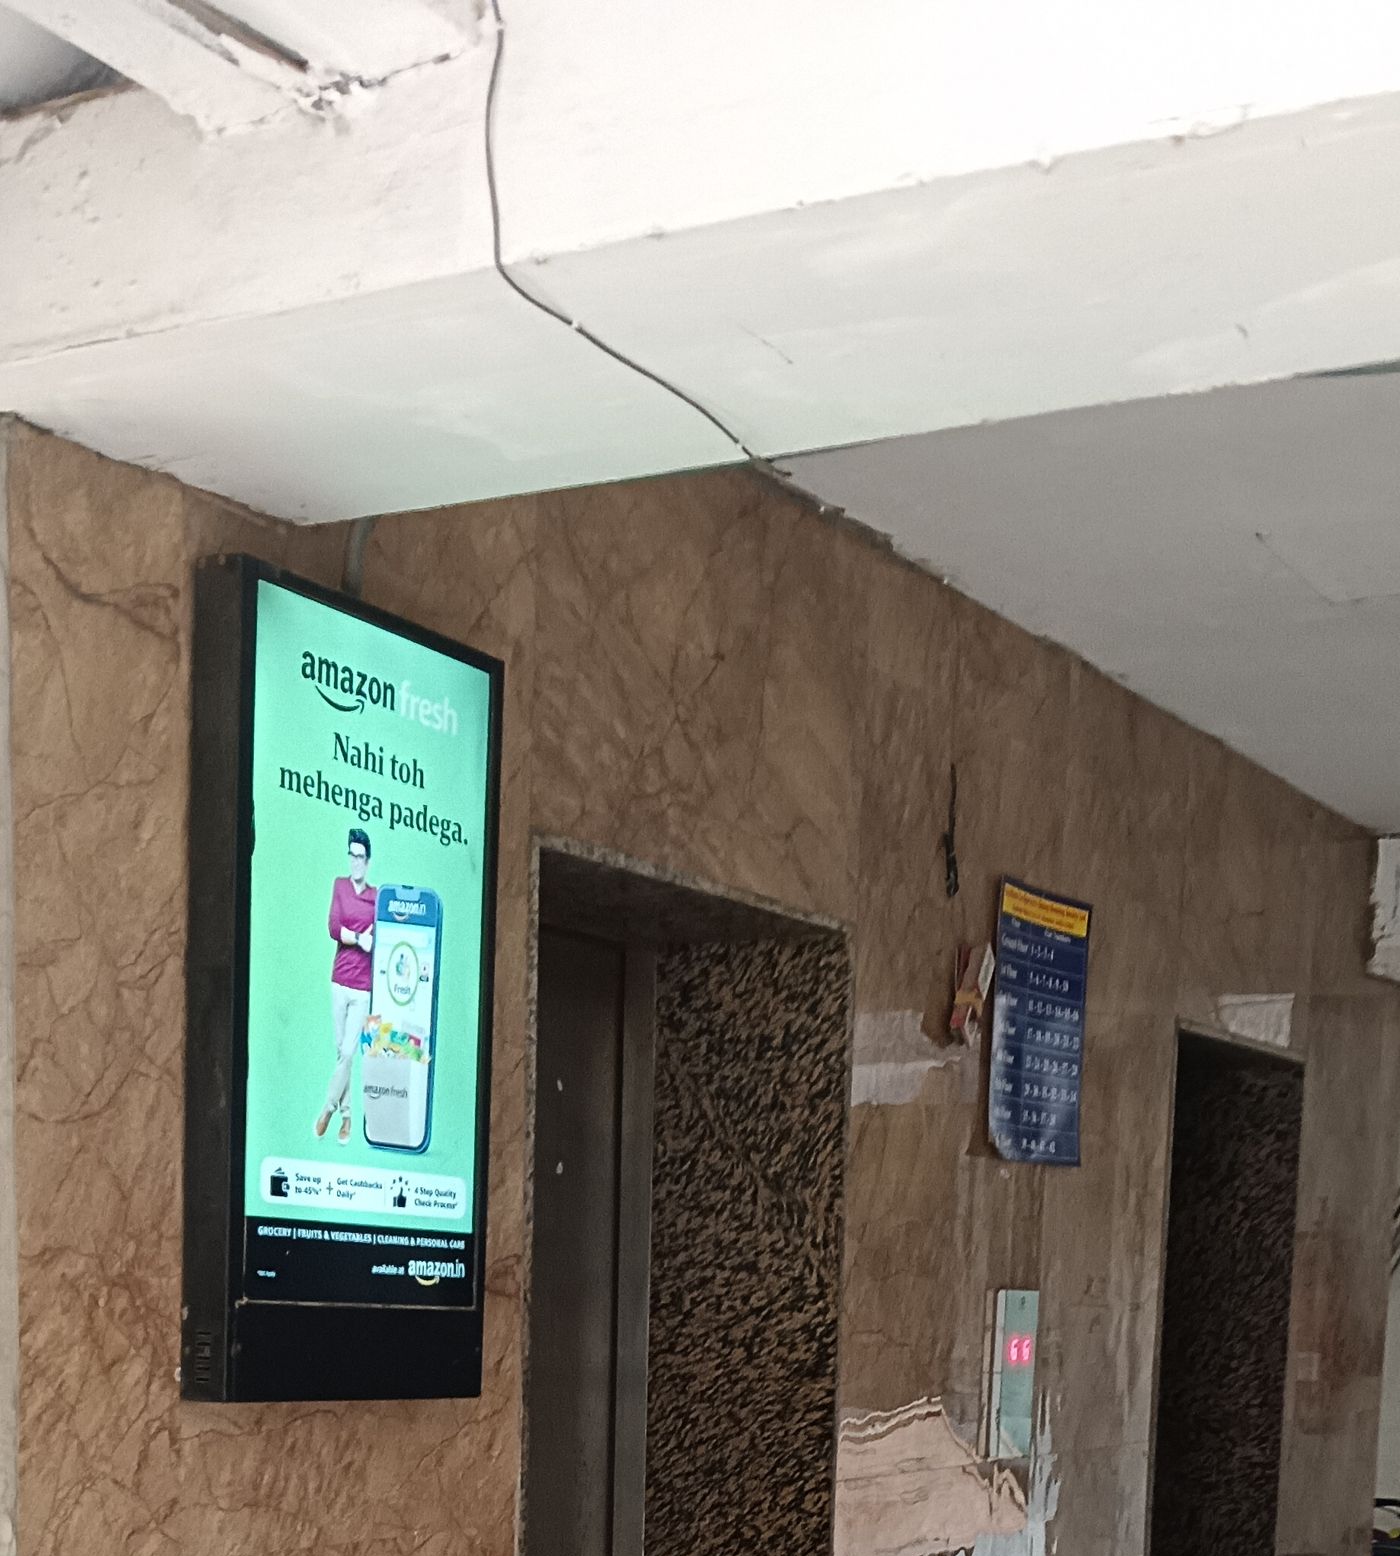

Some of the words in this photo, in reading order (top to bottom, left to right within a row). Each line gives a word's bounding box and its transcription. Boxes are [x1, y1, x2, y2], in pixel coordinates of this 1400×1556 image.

[301, 650, 396, 711] amazon
[399, 680, 459, 736] fresh
[333, 732, 384, 776] Nahi
[390, 753, 425, 789] toh
[279, 766, 383, 822] mehenga
[389, 801, 468, 846] padega.
[387, 900, 426, 917] amazon.in
[394, 983, 411, 995] Fresh
[363, 1085, 390, 1097] amazon
[390, 1086, 408, 1098] fresh
[295, 1173, 312, 1183] Save
[337, 1177, 349, 1186] Get
[295, 1185, 303, 1194] to
[420, 1187, 433, 1196] Step
[435, 1188, 456, 1199] Quality
[414, 1198, 432, 1207] Check
[257, 1225, 292, 1237] GROCERY
[297, 1228, 322, 1239] FRUITS
[323, 1230, 330, 1240] &
[330, 1231, 372, 1243] VEGETABLES
[377, 1234, 409, 1246] CLEANING
[410, 1237, 416, 1246] &
[416, 1237, 448, 1249] PERSONAL
[449, 1239, 465, 1250] CARE
[371, 1264, 398, 1275] available
[408, 1259, 465, 1278] amazon.in
